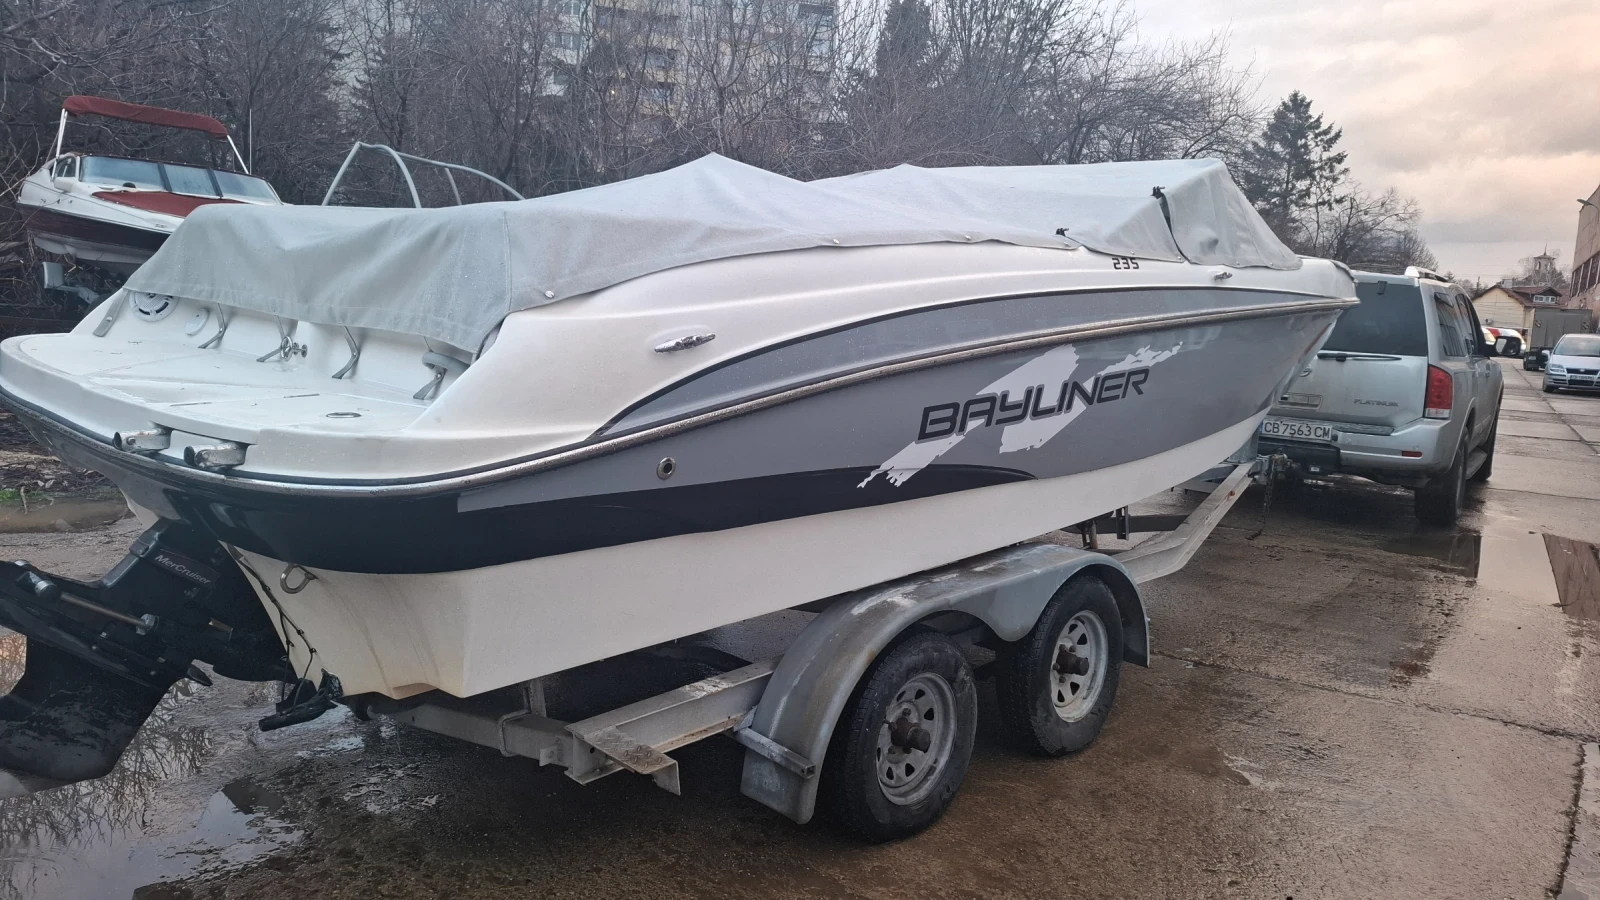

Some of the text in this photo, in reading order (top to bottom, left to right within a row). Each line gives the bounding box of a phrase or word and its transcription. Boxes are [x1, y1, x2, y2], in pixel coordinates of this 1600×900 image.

[1112, 257, 1140, 270] 235
[916, 367, 1150, 442] BAYLINER
[1354, 398, 1399, 407] PLATINUM
[1264, 421, 1331, 439] CB 7563 CM
[155, 554, 212, 584] MerCruiser
